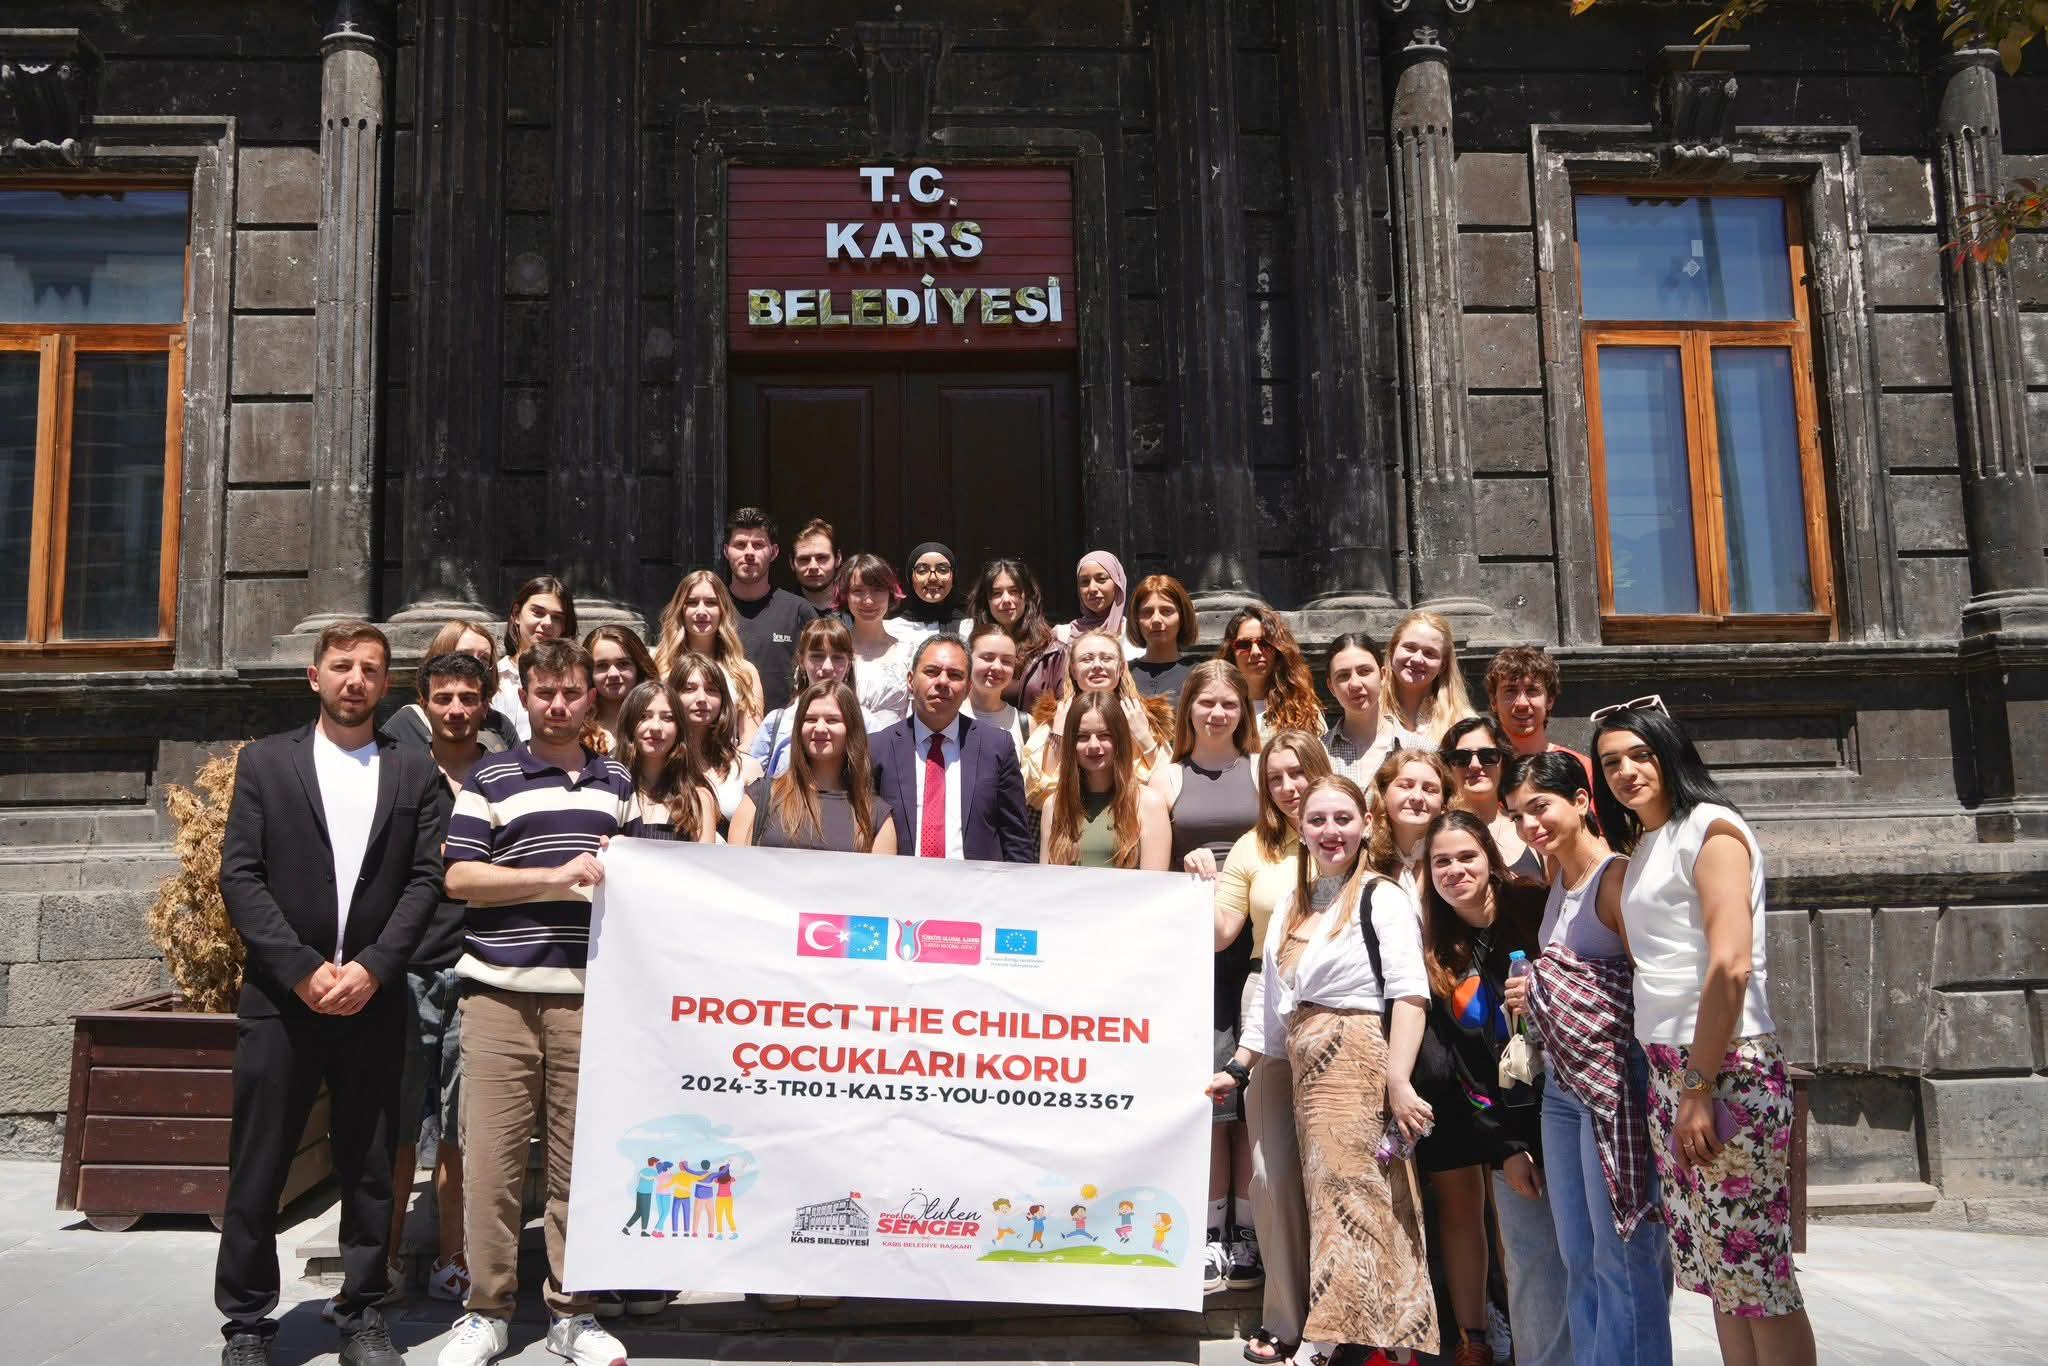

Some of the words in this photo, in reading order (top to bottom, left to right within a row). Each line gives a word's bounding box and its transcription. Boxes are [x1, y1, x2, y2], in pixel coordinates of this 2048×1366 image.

[860, 167, 958, 207] T.C.
[826, 221, 983, 259] KARS
[748, 274, 1063, 326] BELEDİYESİ
[671, 995, 858, 1031] PROTECT
[865, 1005, 944, 1035] THE
[952, 1009, 1150, 1044] CHILDREN
[732, 1042, 966, 1078] ÇOCUKLARI
[975, 1053, 1087, 1084] KORU
[681, 1074, 1135, 1111] 2024-3-TR01-KA153-YOU-000283367
[818, 1238, 869, 1247] BELEDİYESİ
[877, 1219, 980, 1237] SENGER
